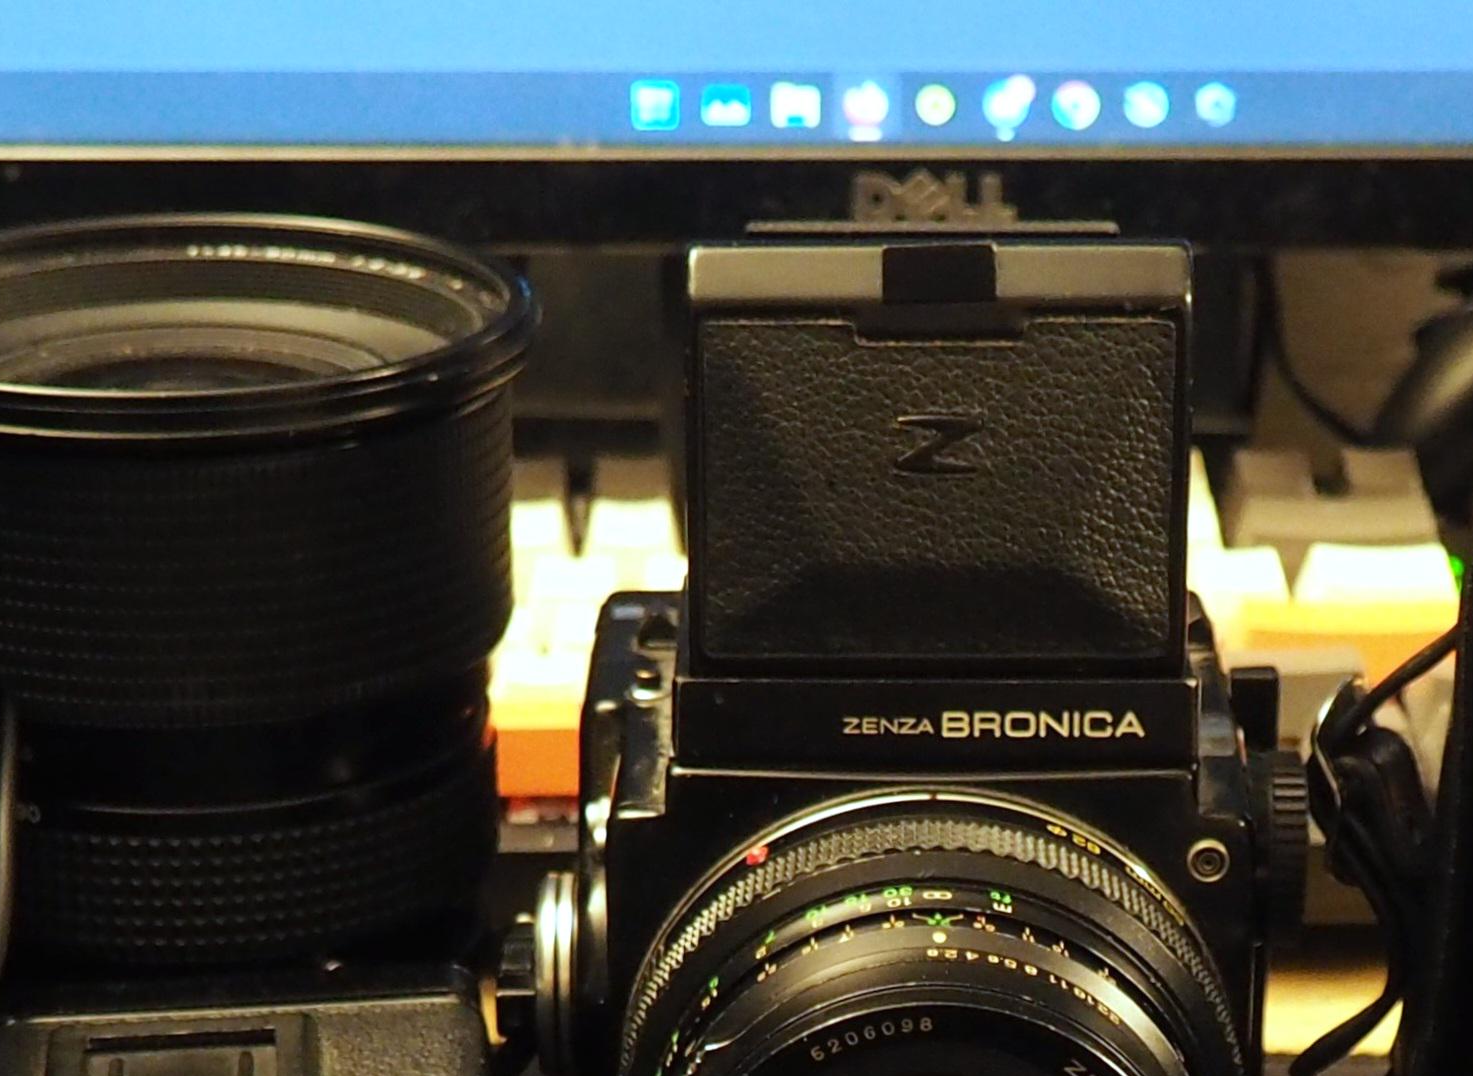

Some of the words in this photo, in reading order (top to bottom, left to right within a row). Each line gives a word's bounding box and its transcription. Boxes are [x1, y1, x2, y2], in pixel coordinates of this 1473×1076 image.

[852, 170, 1016, 223] DELL
[841, 717, 935, 735] ZENZA
[941, 710, 1146, 739] BRONICA
